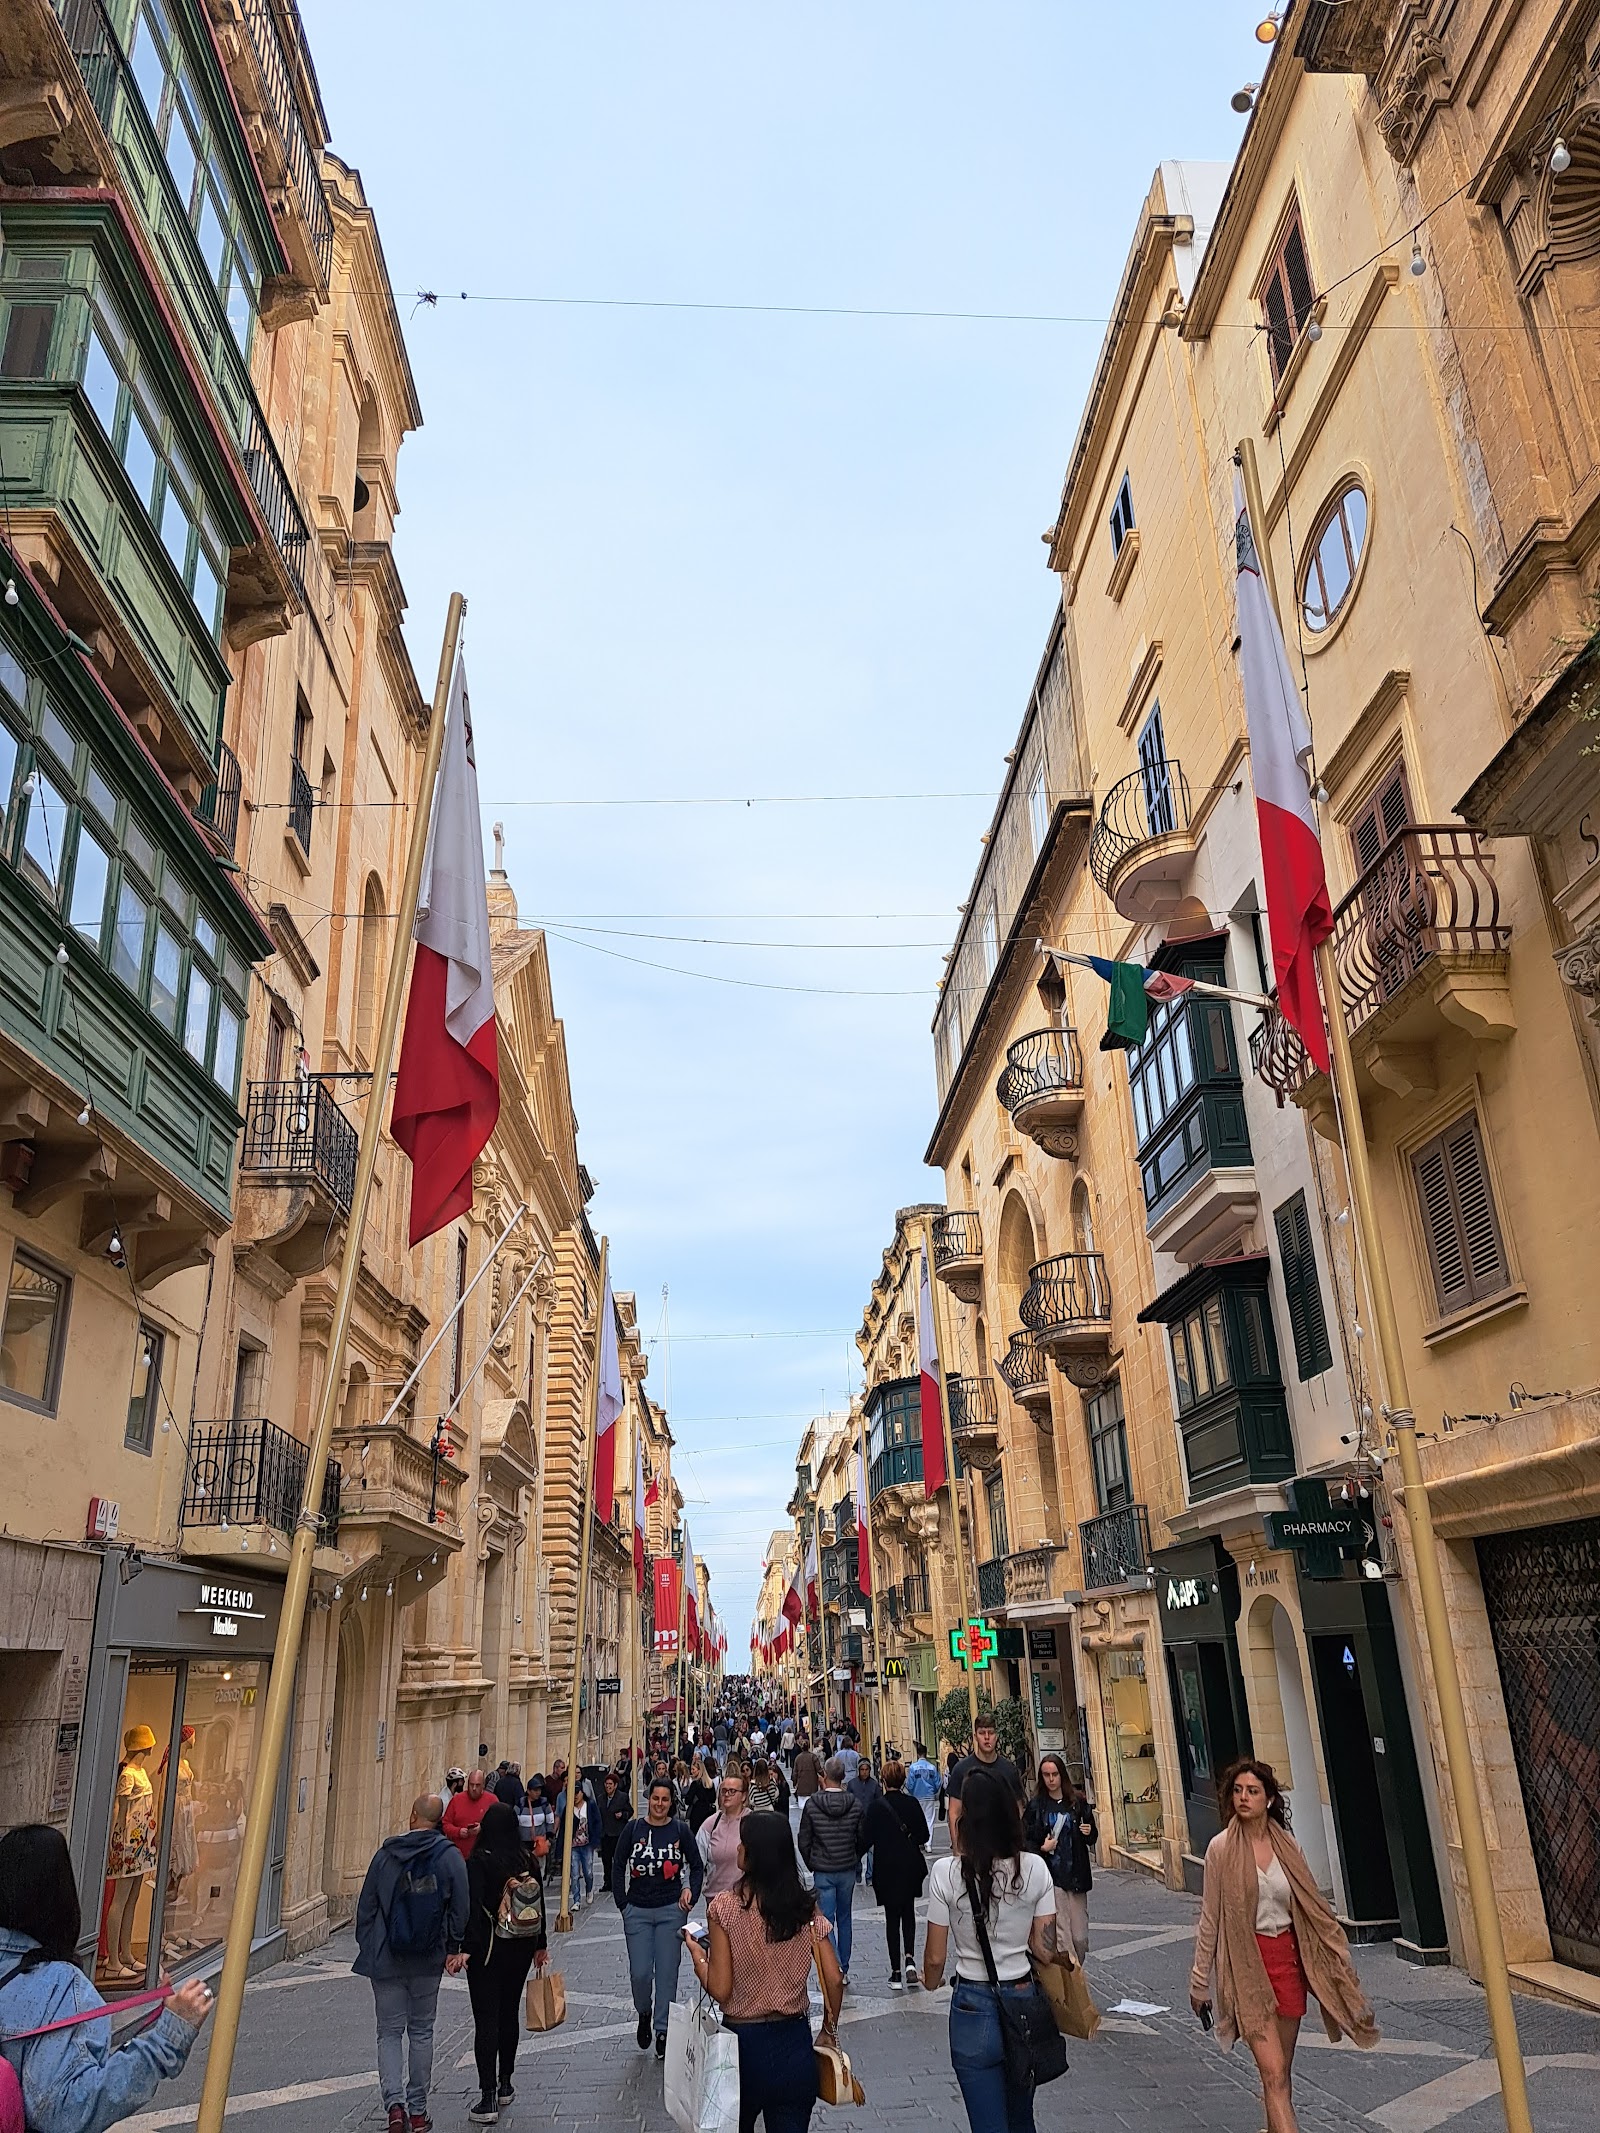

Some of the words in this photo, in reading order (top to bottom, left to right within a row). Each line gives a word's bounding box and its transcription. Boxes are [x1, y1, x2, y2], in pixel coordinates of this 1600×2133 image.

[1282, 1520, 1352, 1536] PHARMACY
[1260, 1568, 1281, 1587] BANK
[201, 1584, 254, 1610] WEEKEND
[1180, 1579, 1199, 1608] APS
[1033, 1674, 1044, 1727] PHARMACY
